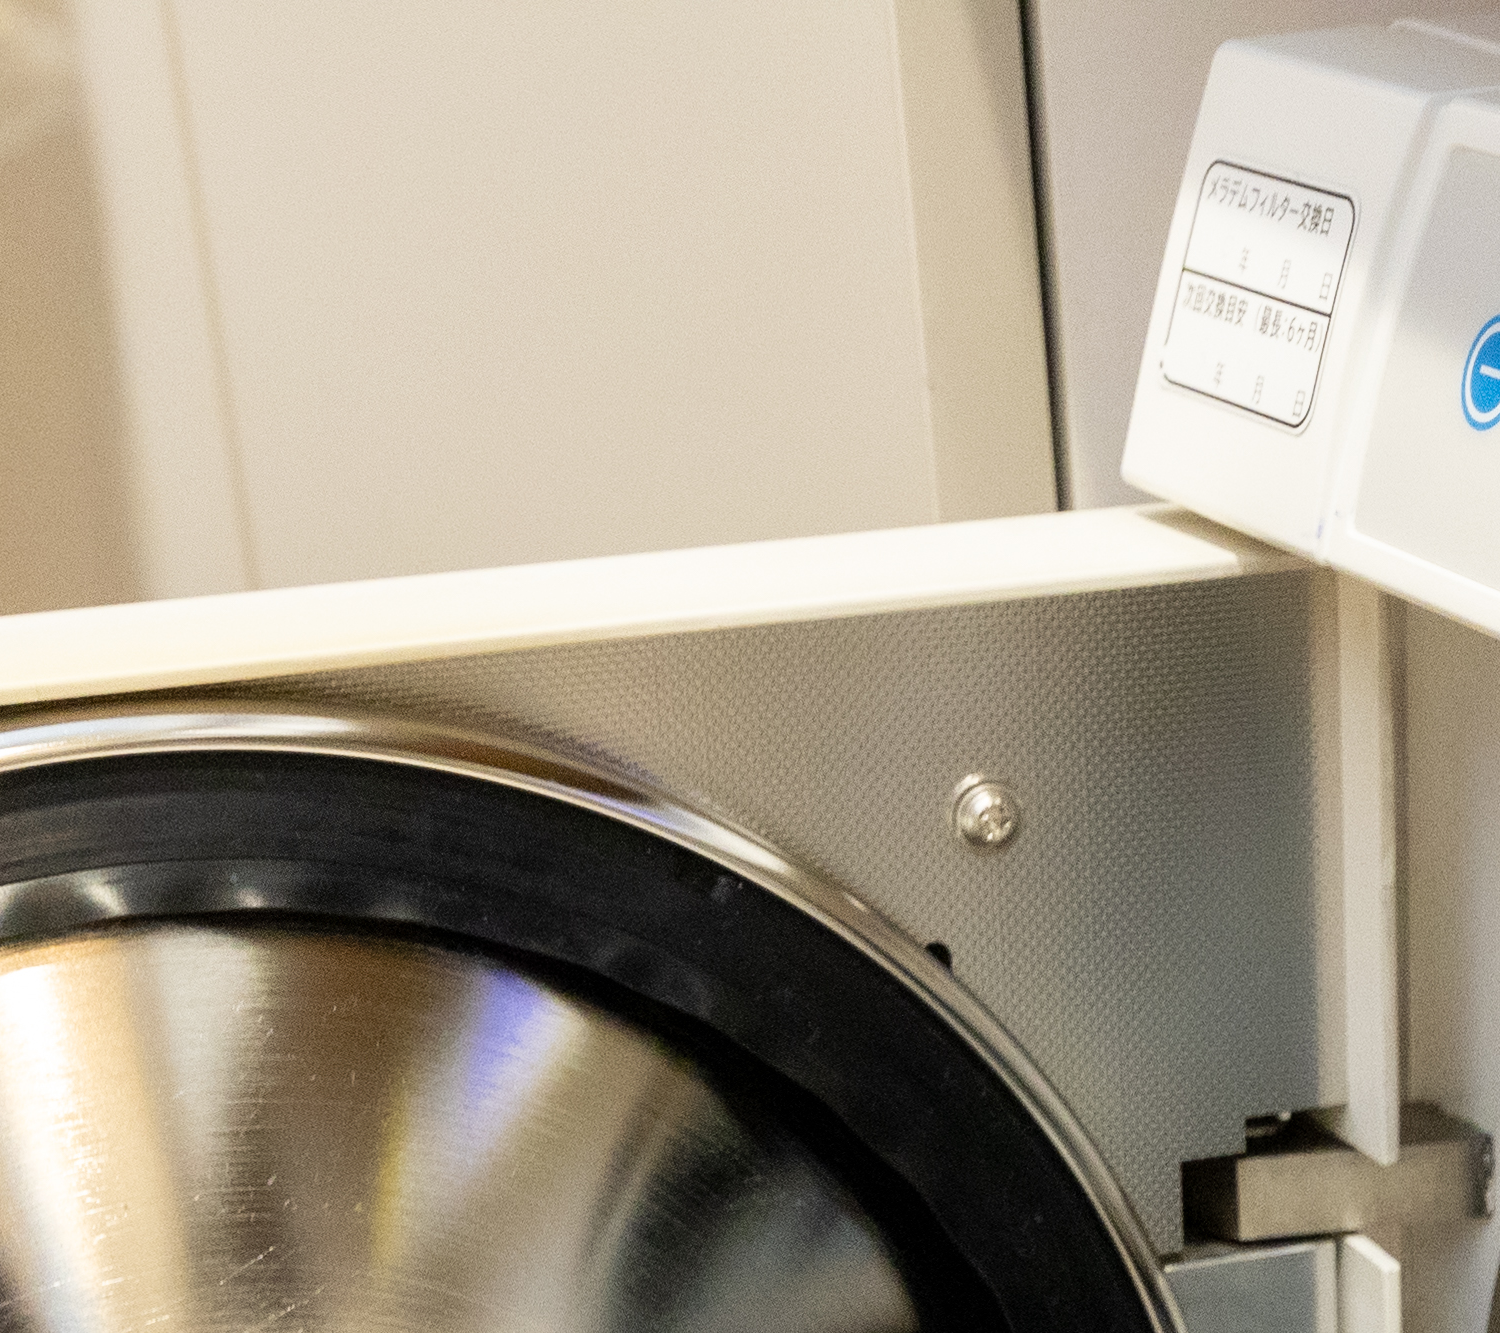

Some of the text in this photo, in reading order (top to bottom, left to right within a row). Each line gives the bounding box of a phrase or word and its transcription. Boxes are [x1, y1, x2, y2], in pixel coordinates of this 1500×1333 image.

[1278, 259, 1292, 289] 月
[1319, 272, 1334, 300] 日
[1252, 375, 1265, 405] 月
[1292, 390, 1306, 418] 日
